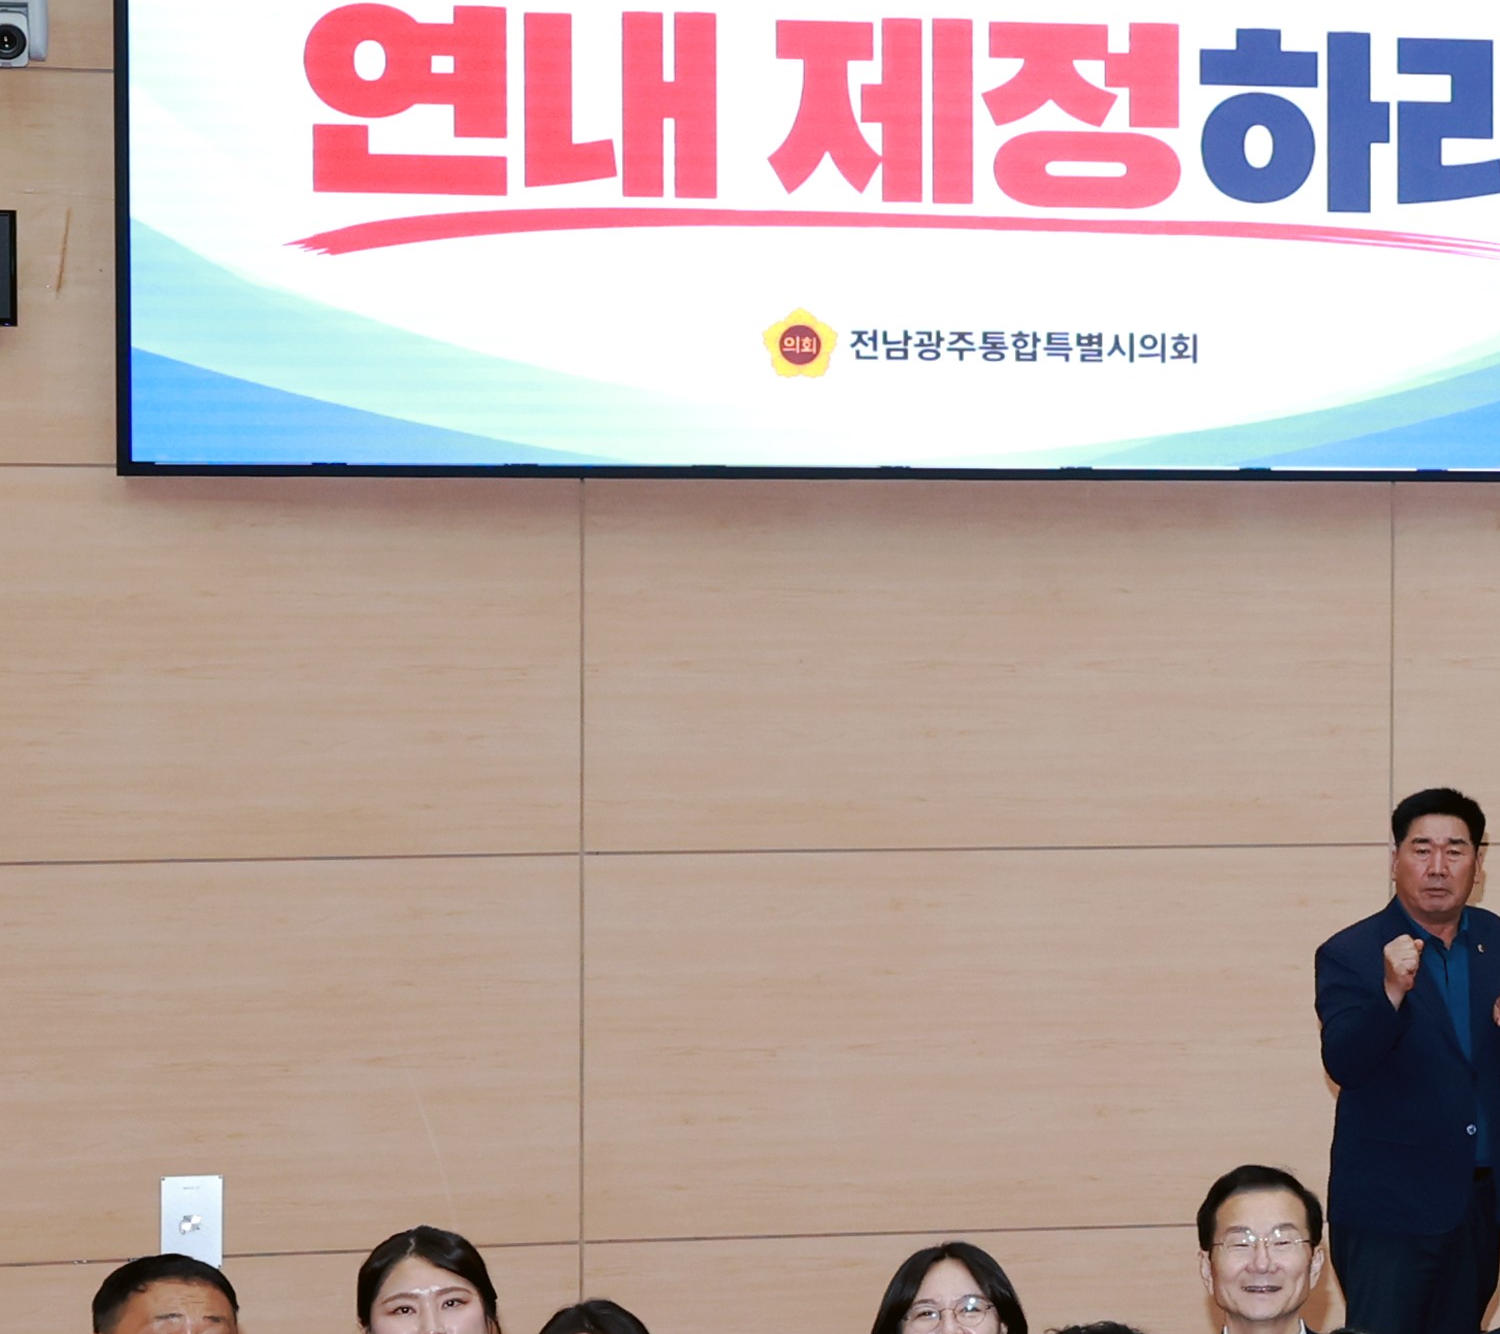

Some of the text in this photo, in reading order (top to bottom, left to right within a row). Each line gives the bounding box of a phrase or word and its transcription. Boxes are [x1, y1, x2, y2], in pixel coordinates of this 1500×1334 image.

[303, 3, 718, 198] 연내
[782, 336, 818, 355] 의회
[849, 329, 1198, 363] 전남광주통합특별시의회
